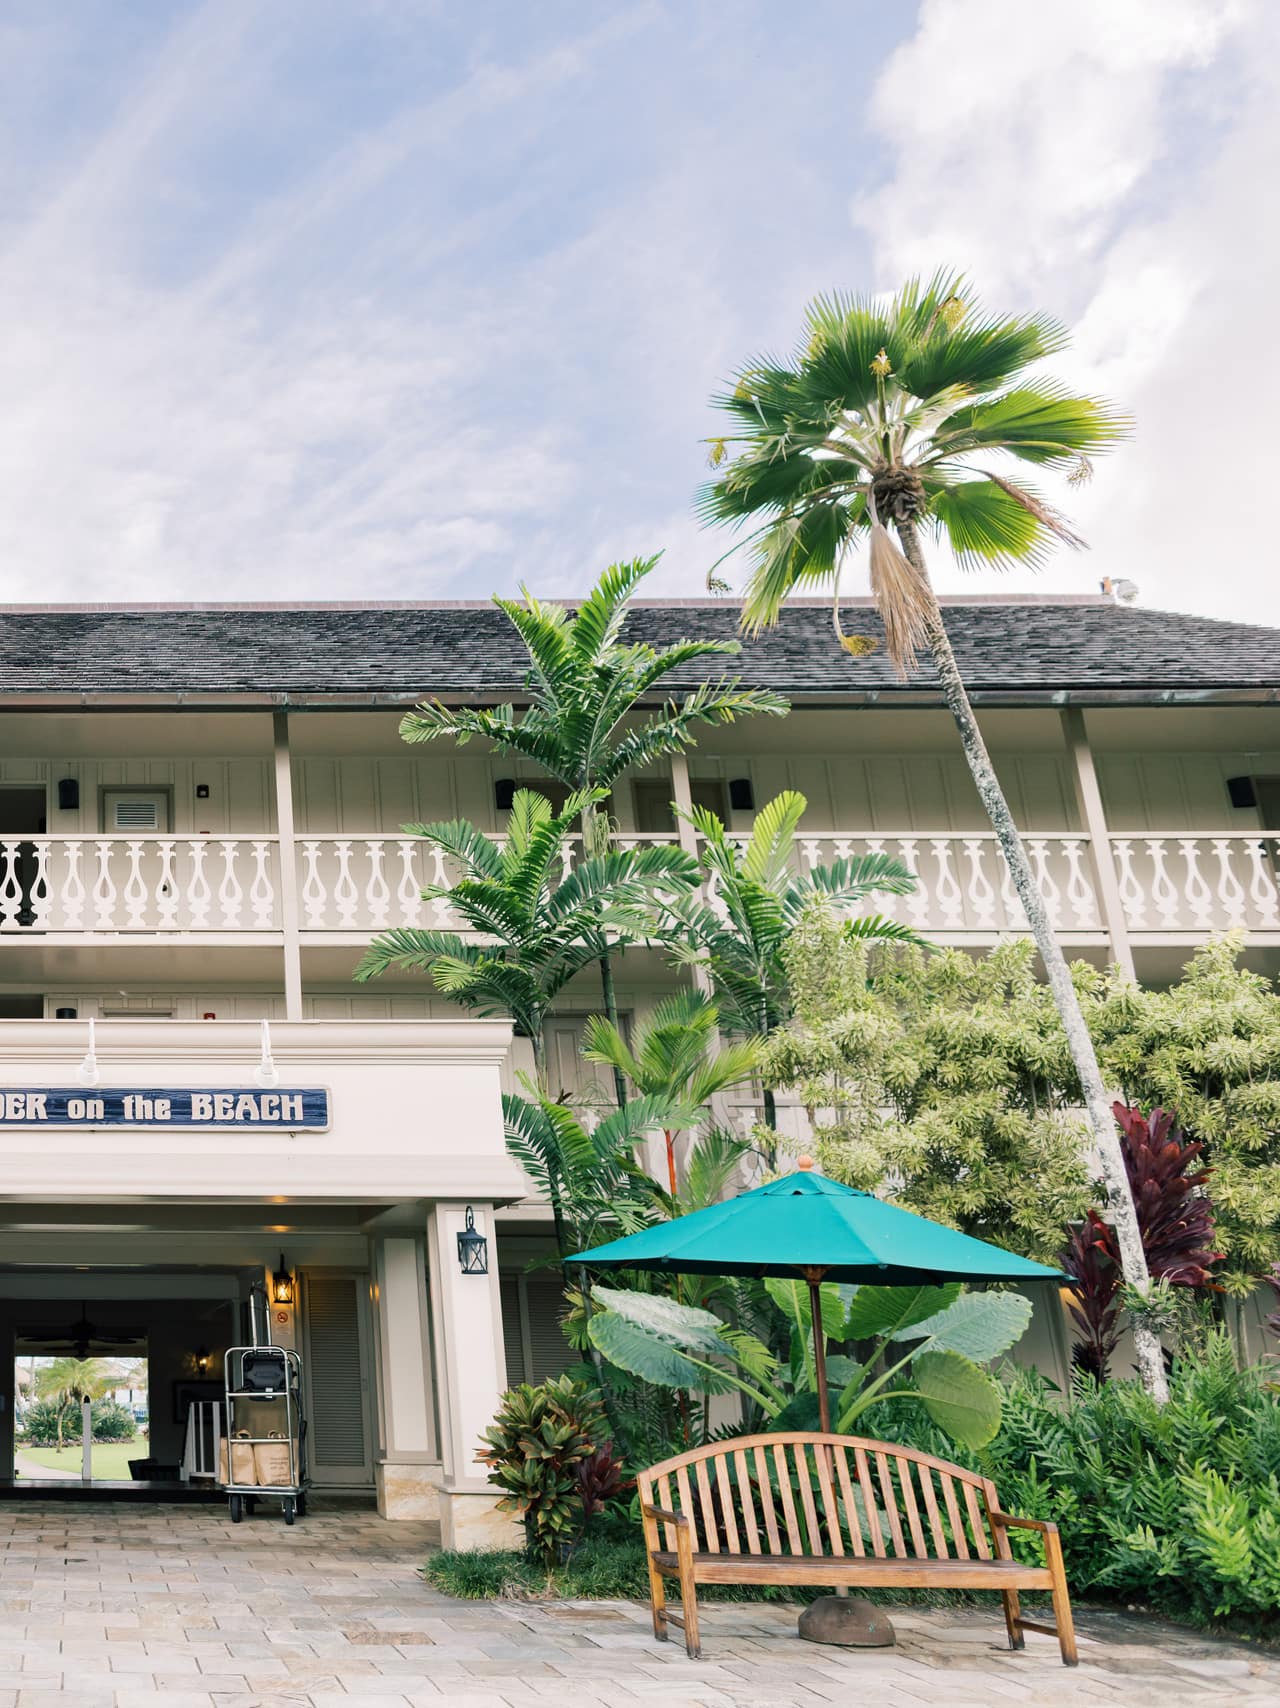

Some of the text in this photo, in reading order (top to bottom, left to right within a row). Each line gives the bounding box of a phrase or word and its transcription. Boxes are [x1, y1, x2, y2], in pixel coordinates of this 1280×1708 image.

[67, 1099, 105, 1120] on
[122, 1094, 172, 1121] the
[191, 1094, 304, 1121] BEACH
